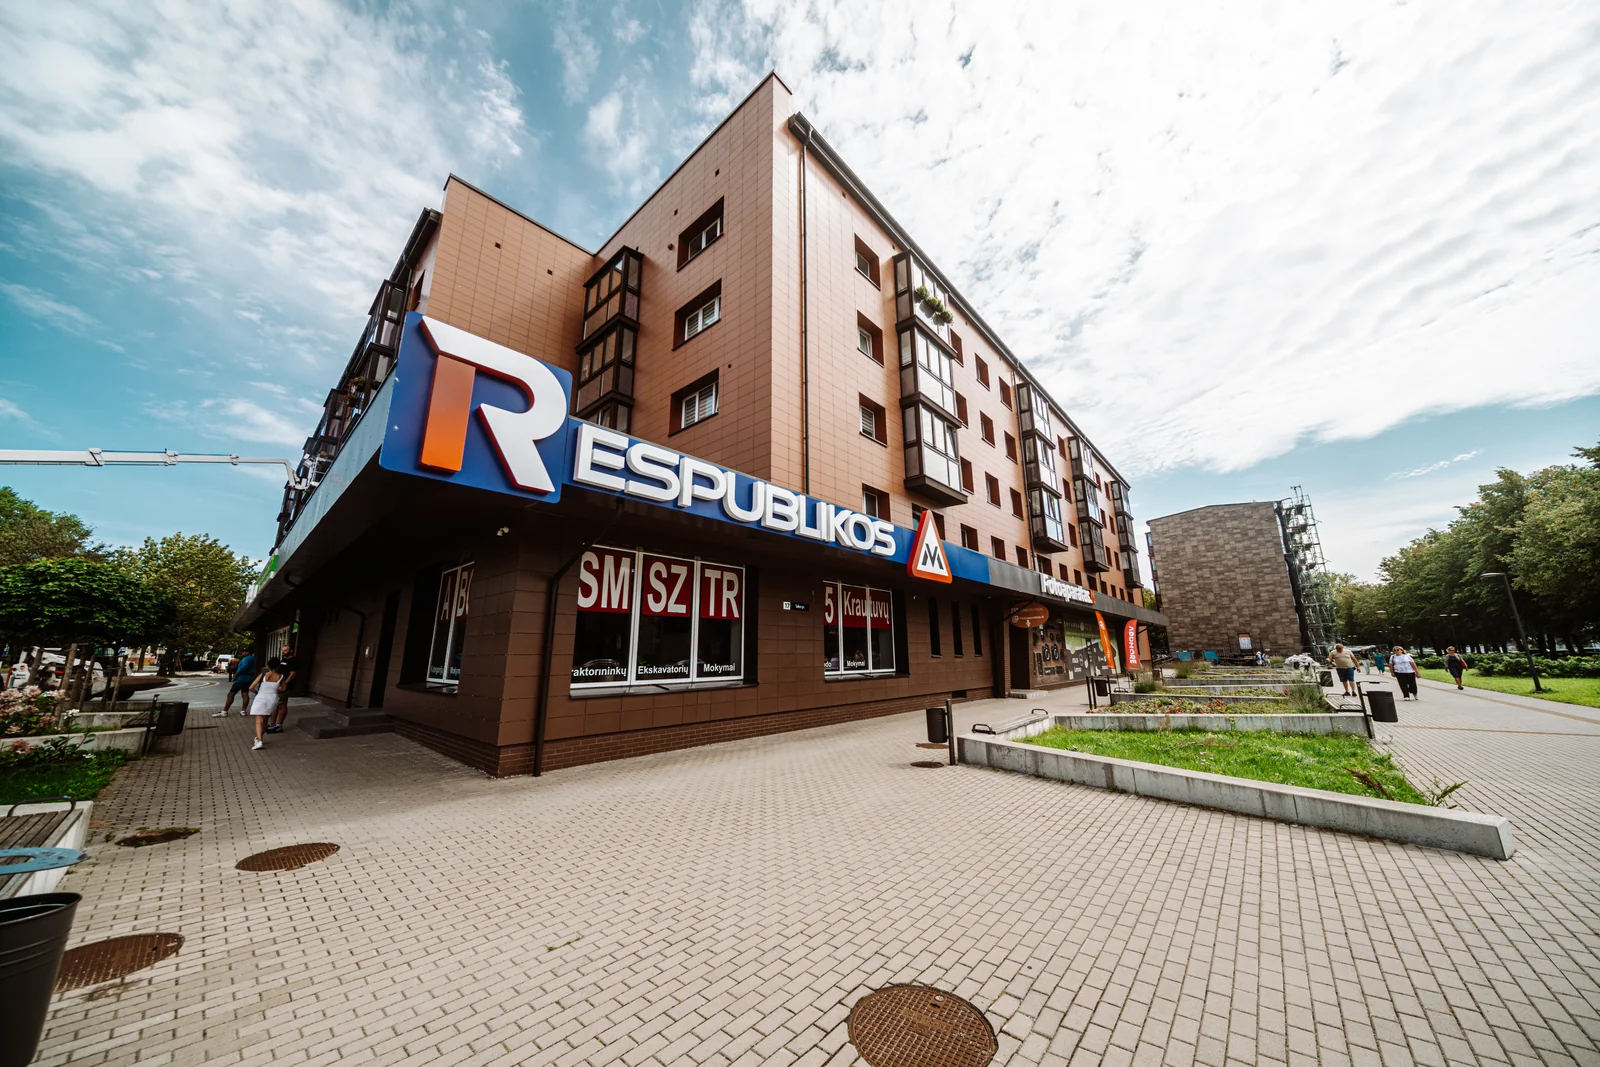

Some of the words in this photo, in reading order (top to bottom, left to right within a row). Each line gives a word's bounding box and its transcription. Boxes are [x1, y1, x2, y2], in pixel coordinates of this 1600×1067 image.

[418, 315, 897, 557] RESPUBLIKOS
[578, 551, 631, 610] SM
[647, 561, 688, 613] SZ
[704, 568, 740, 618] TR
[637, 665, 689, 675] Ekskavatorių
[703, 662, 736, 673] Mokymai
[846, 660, 866, 668] Mokymai
